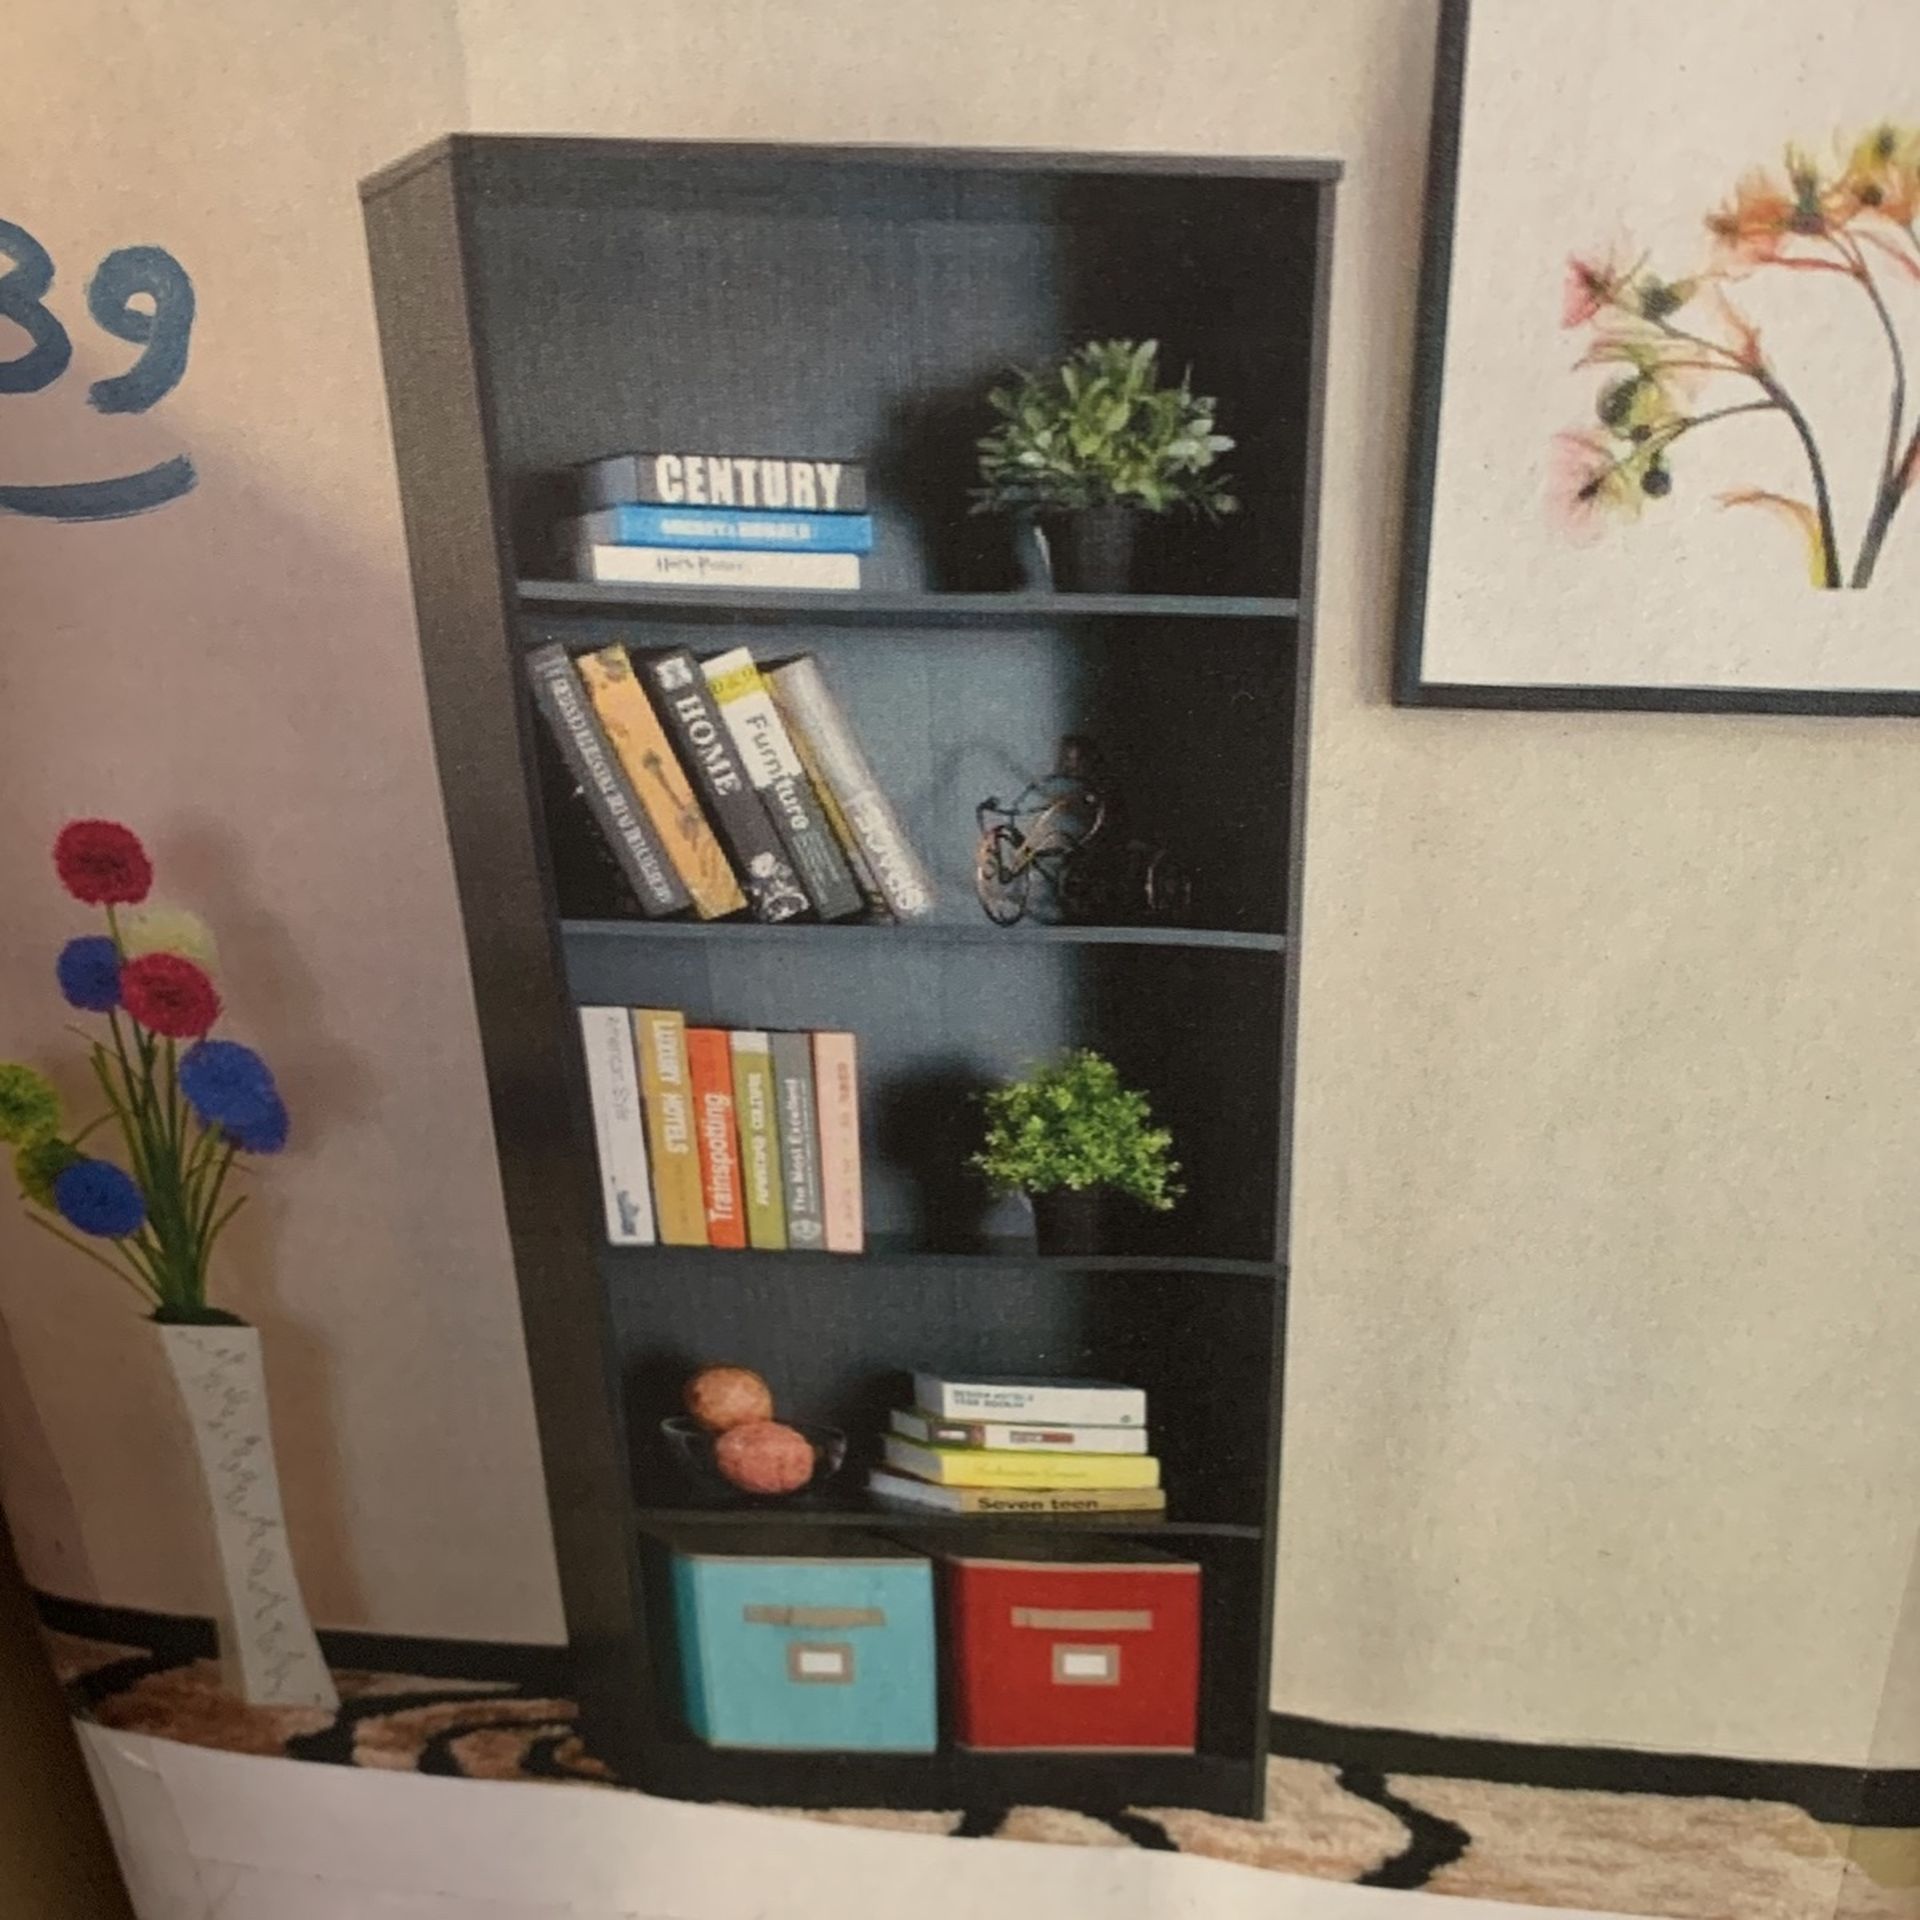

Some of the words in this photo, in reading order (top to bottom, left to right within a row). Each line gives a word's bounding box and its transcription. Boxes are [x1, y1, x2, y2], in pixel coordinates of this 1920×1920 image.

[655, 454, 841, 509] CENTURY
[674, 694, 741, 797] HOME
[745, 712, 809, 832] Furniture
[662, 1092, 689, 1155] HOTELS
[785, 1078, 802, 1148] Excellent
[704, 1092, 733, 1222] Trainspotting
[789, 1151, 806, 1184] Most
[792, 1187, 806, 1211] The
[978, 1497, 1044, 1511] Seven
[1050, 1498, 1099, 1511] teen
